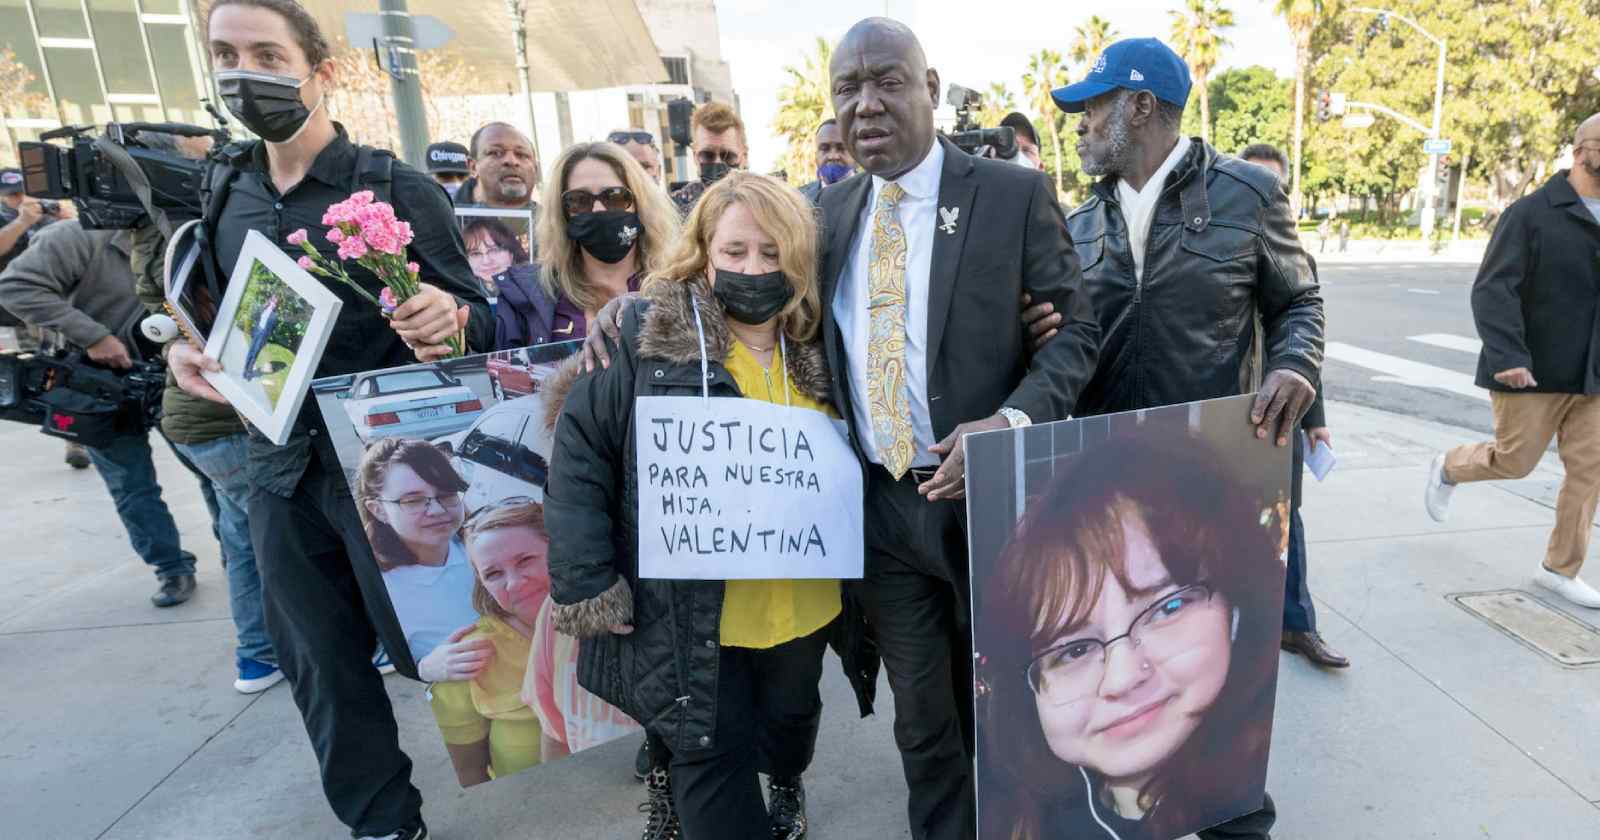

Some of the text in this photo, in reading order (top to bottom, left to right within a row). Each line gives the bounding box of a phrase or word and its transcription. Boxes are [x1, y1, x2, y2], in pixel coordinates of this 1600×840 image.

[651, 417, 814, 461] JUSTICIA
[648, 462, 820, 493] PARA NUESTRA
[661, 492, 721, 517] HIJA,
[660, 523, 826, 557] VALENTINA
